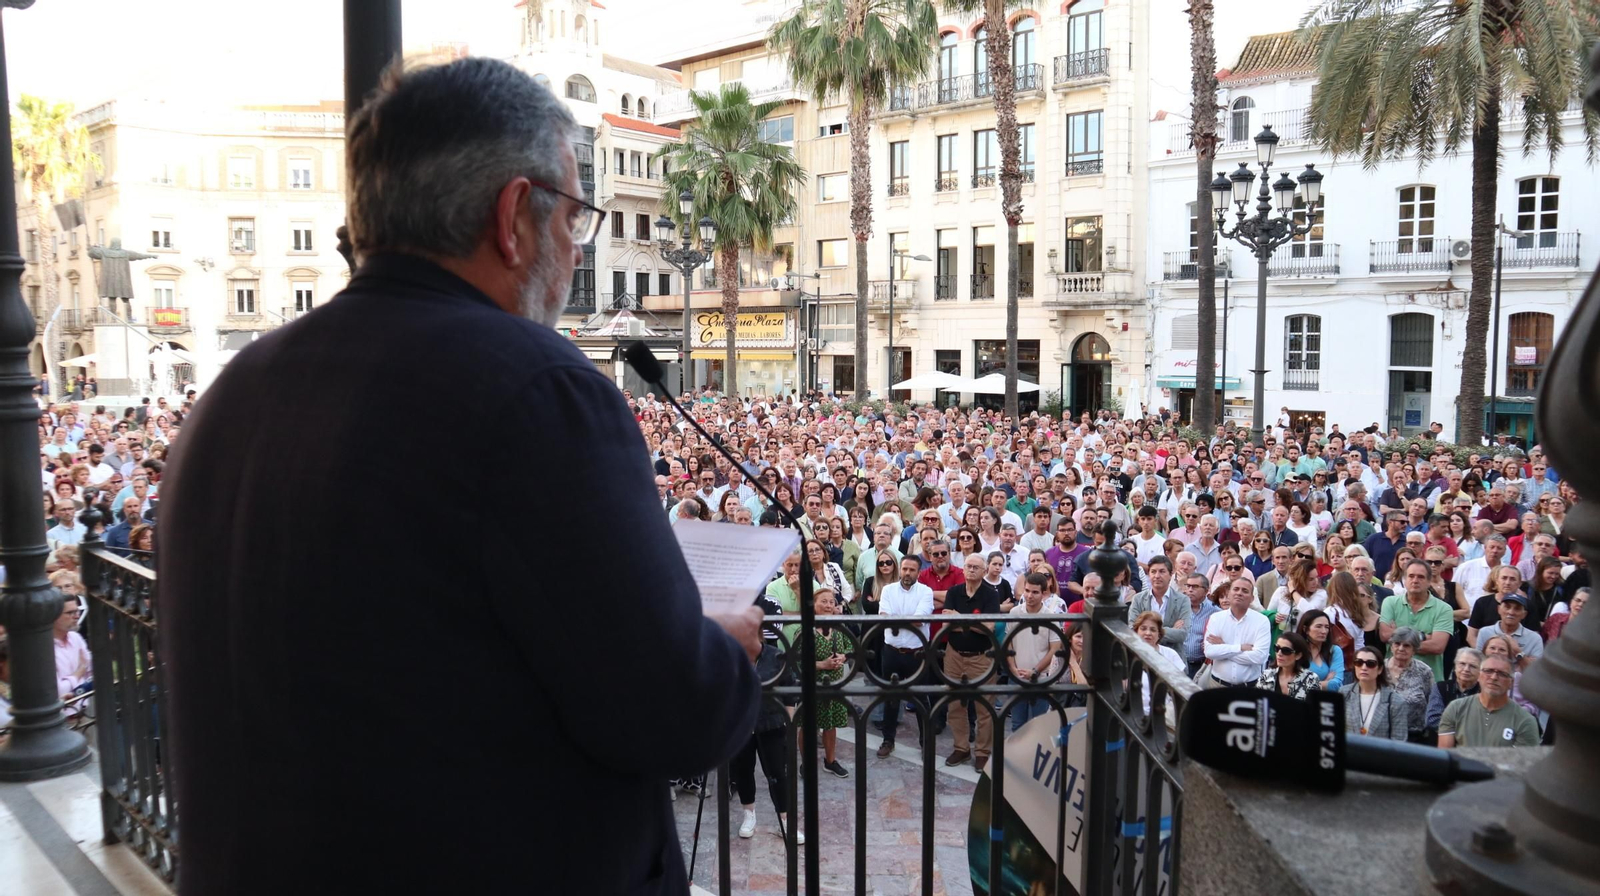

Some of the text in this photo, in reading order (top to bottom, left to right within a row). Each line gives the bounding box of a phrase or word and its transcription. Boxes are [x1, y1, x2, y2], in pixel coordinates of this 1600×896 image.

[754, 314, 784, 327] Plaza
[1217, 700, 1256, 752] ah
[1319, 702, 1336, 769] 97.3 FM
[1502, 727, 1514, 741] G
